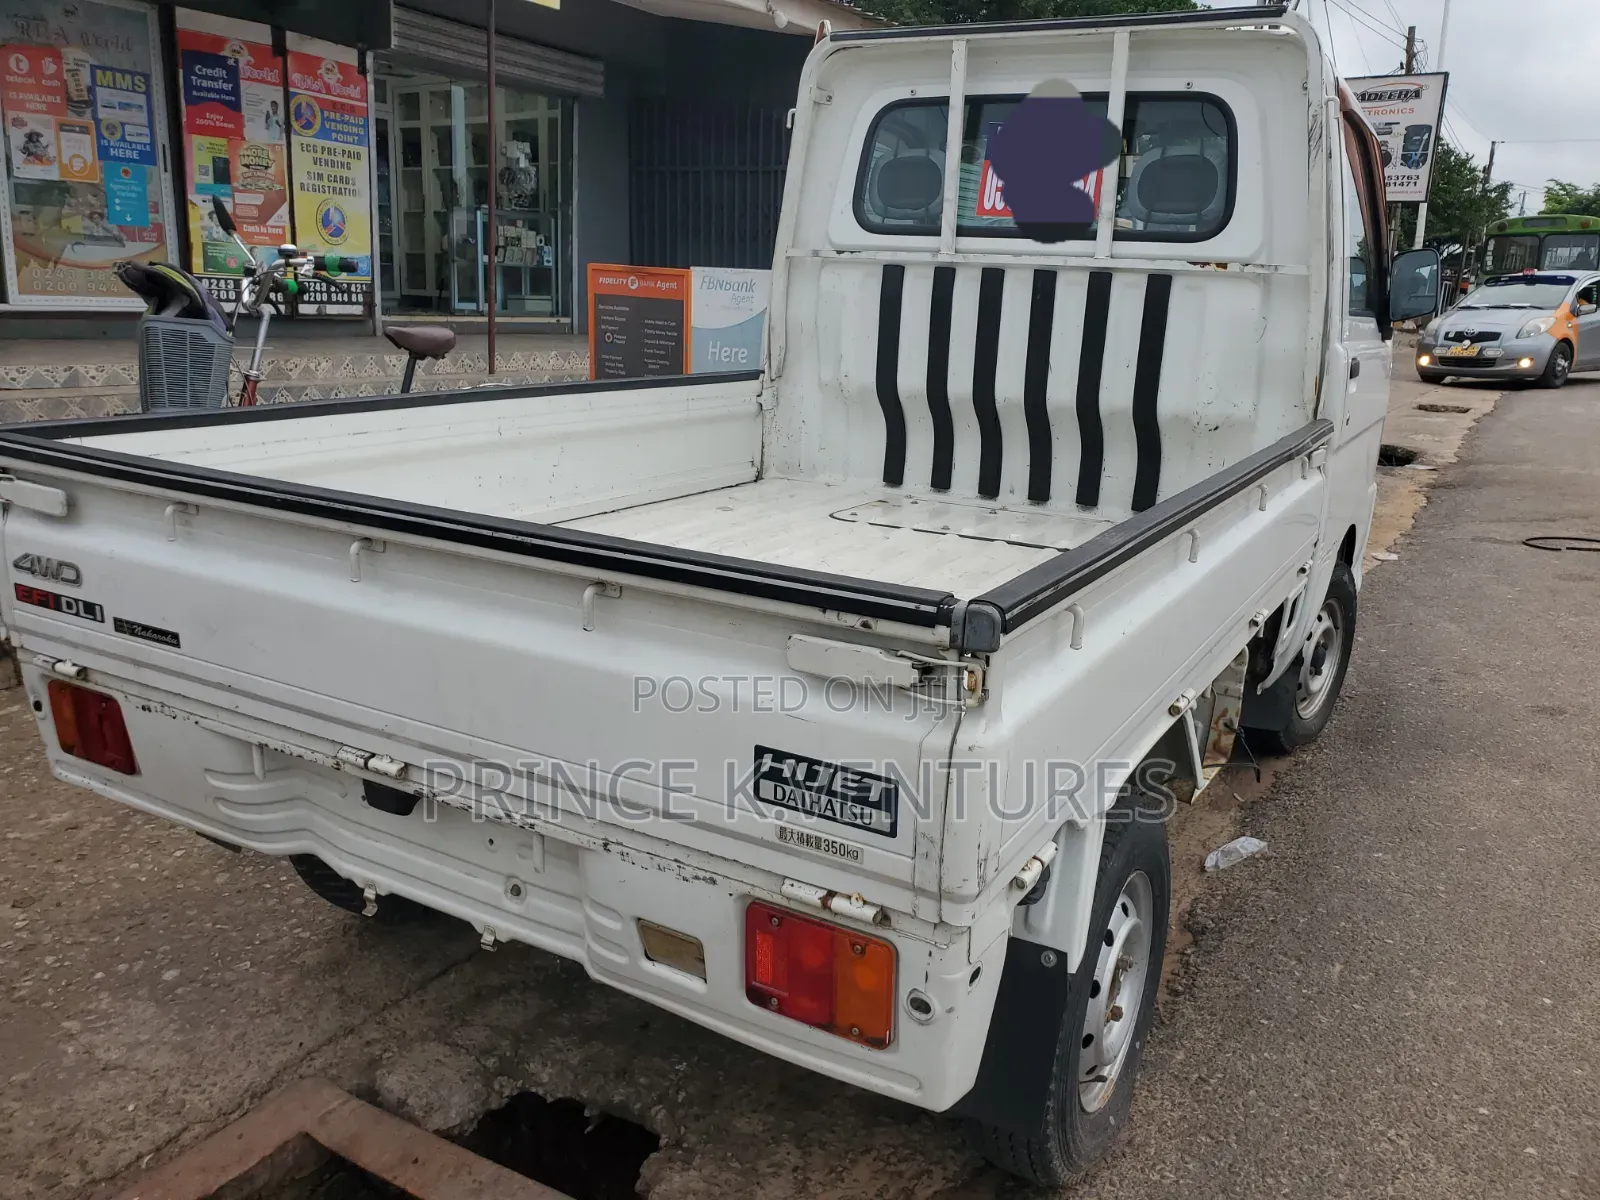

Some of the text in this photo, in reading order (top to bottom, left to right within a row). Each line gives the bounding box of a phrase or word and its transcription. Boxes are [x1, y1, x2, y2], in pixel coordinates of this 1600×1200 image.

[195, 64, 228, 79] Credit
[95, 69, 147, 93] MMS
[191, 76, 234, 91] Transfer
[8, 91, 62, 103] IS AVAILABLE
[192, 90, 236, 101] Available Here
[26, 102, 48, 111] HERE
[1363, 107, 1415, 117] TRONICS
[205, 112, 224, 122] Enjoy
[323, 110, 365, 125] PRE-PAID
[324, 120, 365, 136] VENDING
[331, 131, 359, 143] POINT
[110, 140, 152, 152] AVAILABLE
[240, 146, 270, 158] MORE
[300, 142, 362, 161] ECG PRE-PAID
[110, 147, 140, 160] HERE
[240, 155, 275, 167] MONEY
[312, 156, 352, 171] VENDING
[306, 171, 357, 187] SIM CARDS
[32, 268, 117, 281] 0243 382
[33, 280, 118, 293] 0200 944
[202, 278, 235, 289] 0243
[598, 276, 678, 290] FIDELITY BANK Agent
[207, 290, 236, 300] 200
[730, 293, 755, 305] Agent
[708, 340, 748, 364] Here
[13, 552, 83, 588] 4WD
[17, 584, 102, 621] EFI DLI
[759, 753, 896, 802] HIJET
[773, 784, 873, 826] DAIHATSU
